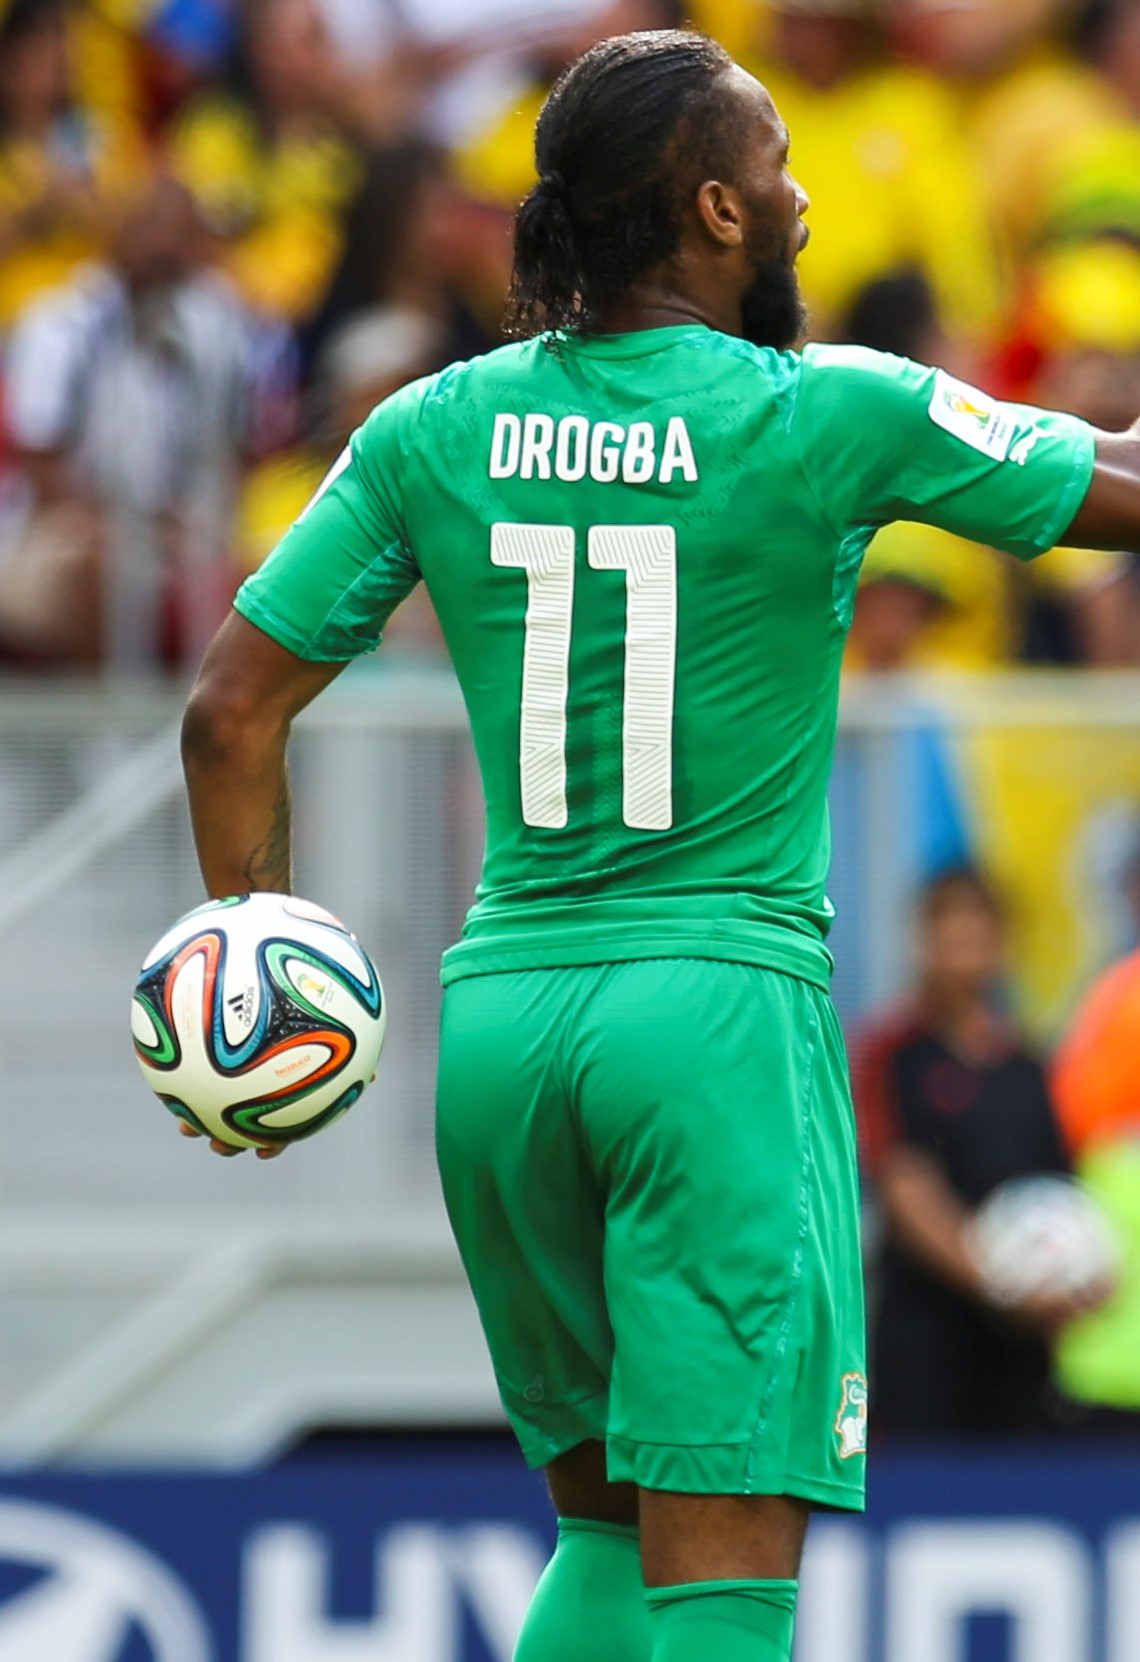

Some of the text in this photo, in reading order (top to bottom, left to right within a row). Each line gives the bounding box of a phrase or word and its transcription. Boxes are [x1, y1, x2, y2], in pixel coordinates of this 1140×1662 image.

[489, 413, 699, 483] DROGBA
[490, 522, 677, 831] 11
[244, 986, 255, 1027] adidas
